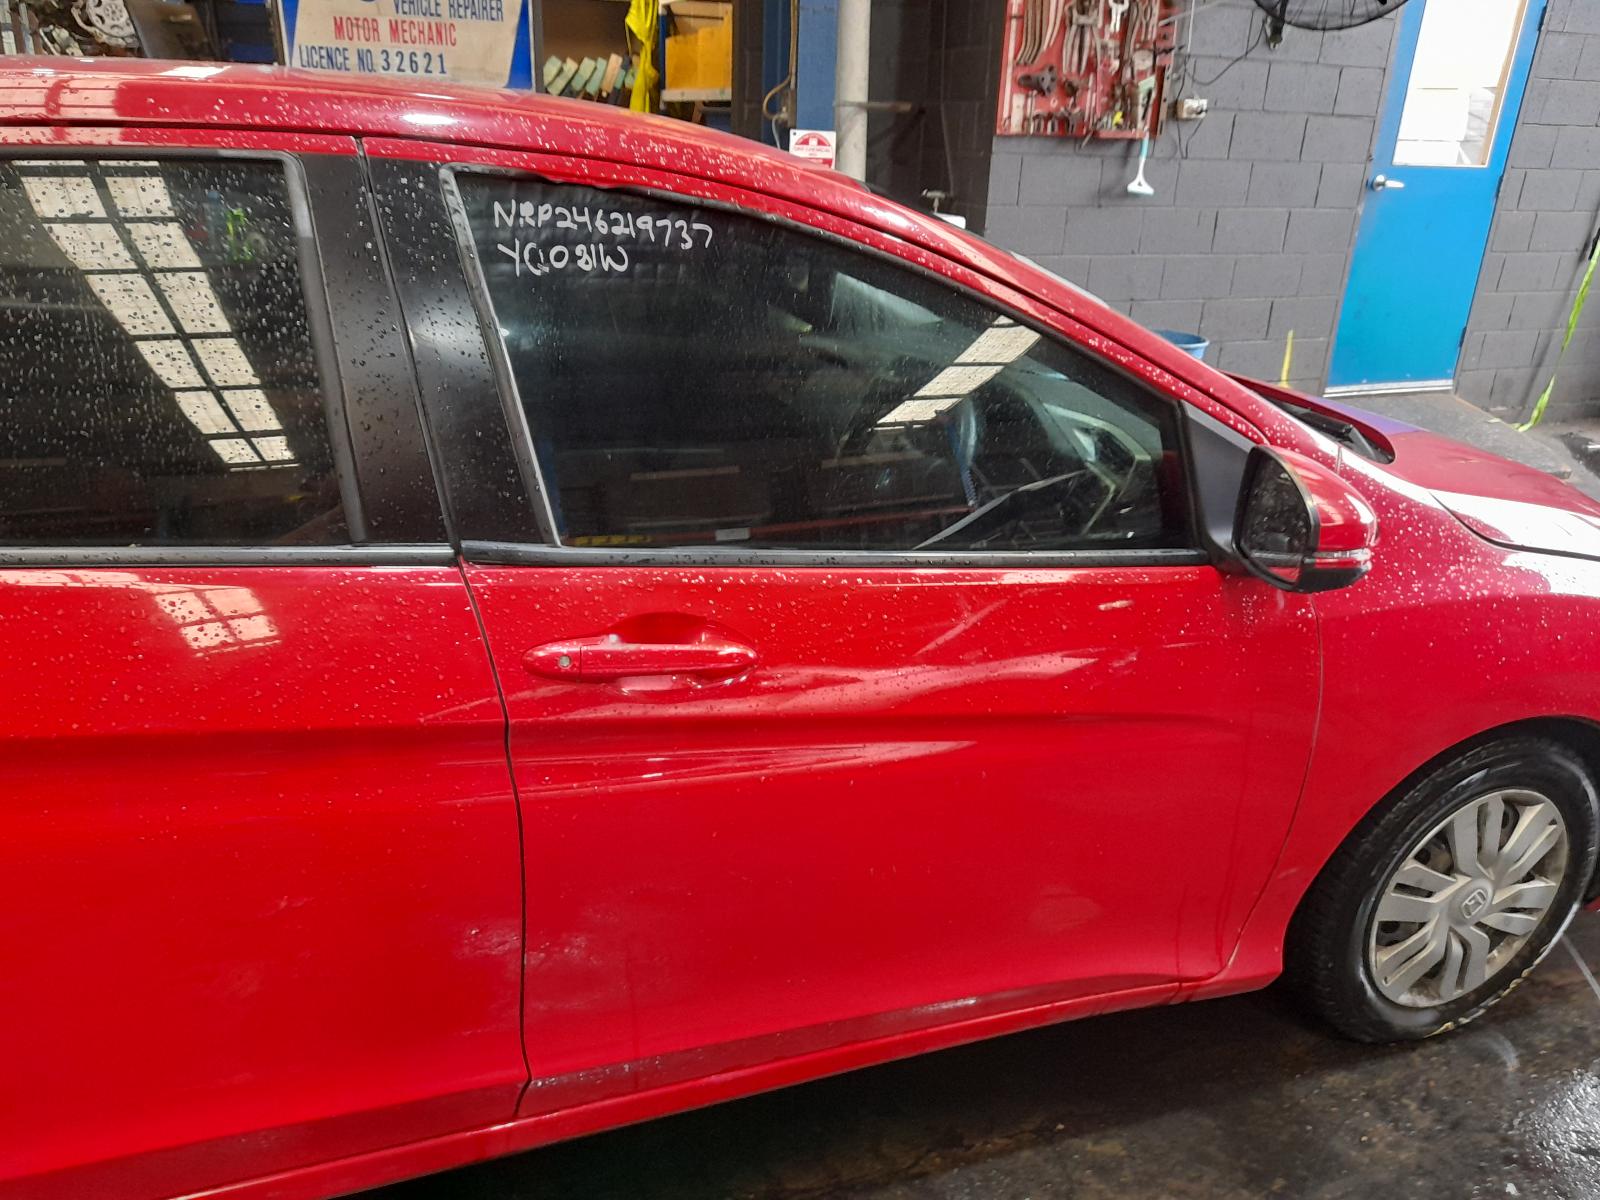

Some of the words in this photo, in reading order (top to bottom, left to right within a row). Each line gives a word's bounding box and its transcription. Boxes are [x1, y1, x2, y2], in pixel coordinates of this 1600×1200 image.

[394, 0, 442, 17] VEHICLE
[448, 0, 503, 22] REPAIRER
[333, 16, 381, 42] MOTOR
[389, 19, 457, 47] MECHANIC
[298, 45, 350, 71] LICENCE
[493, 199, 713, 250] NRP246219737
